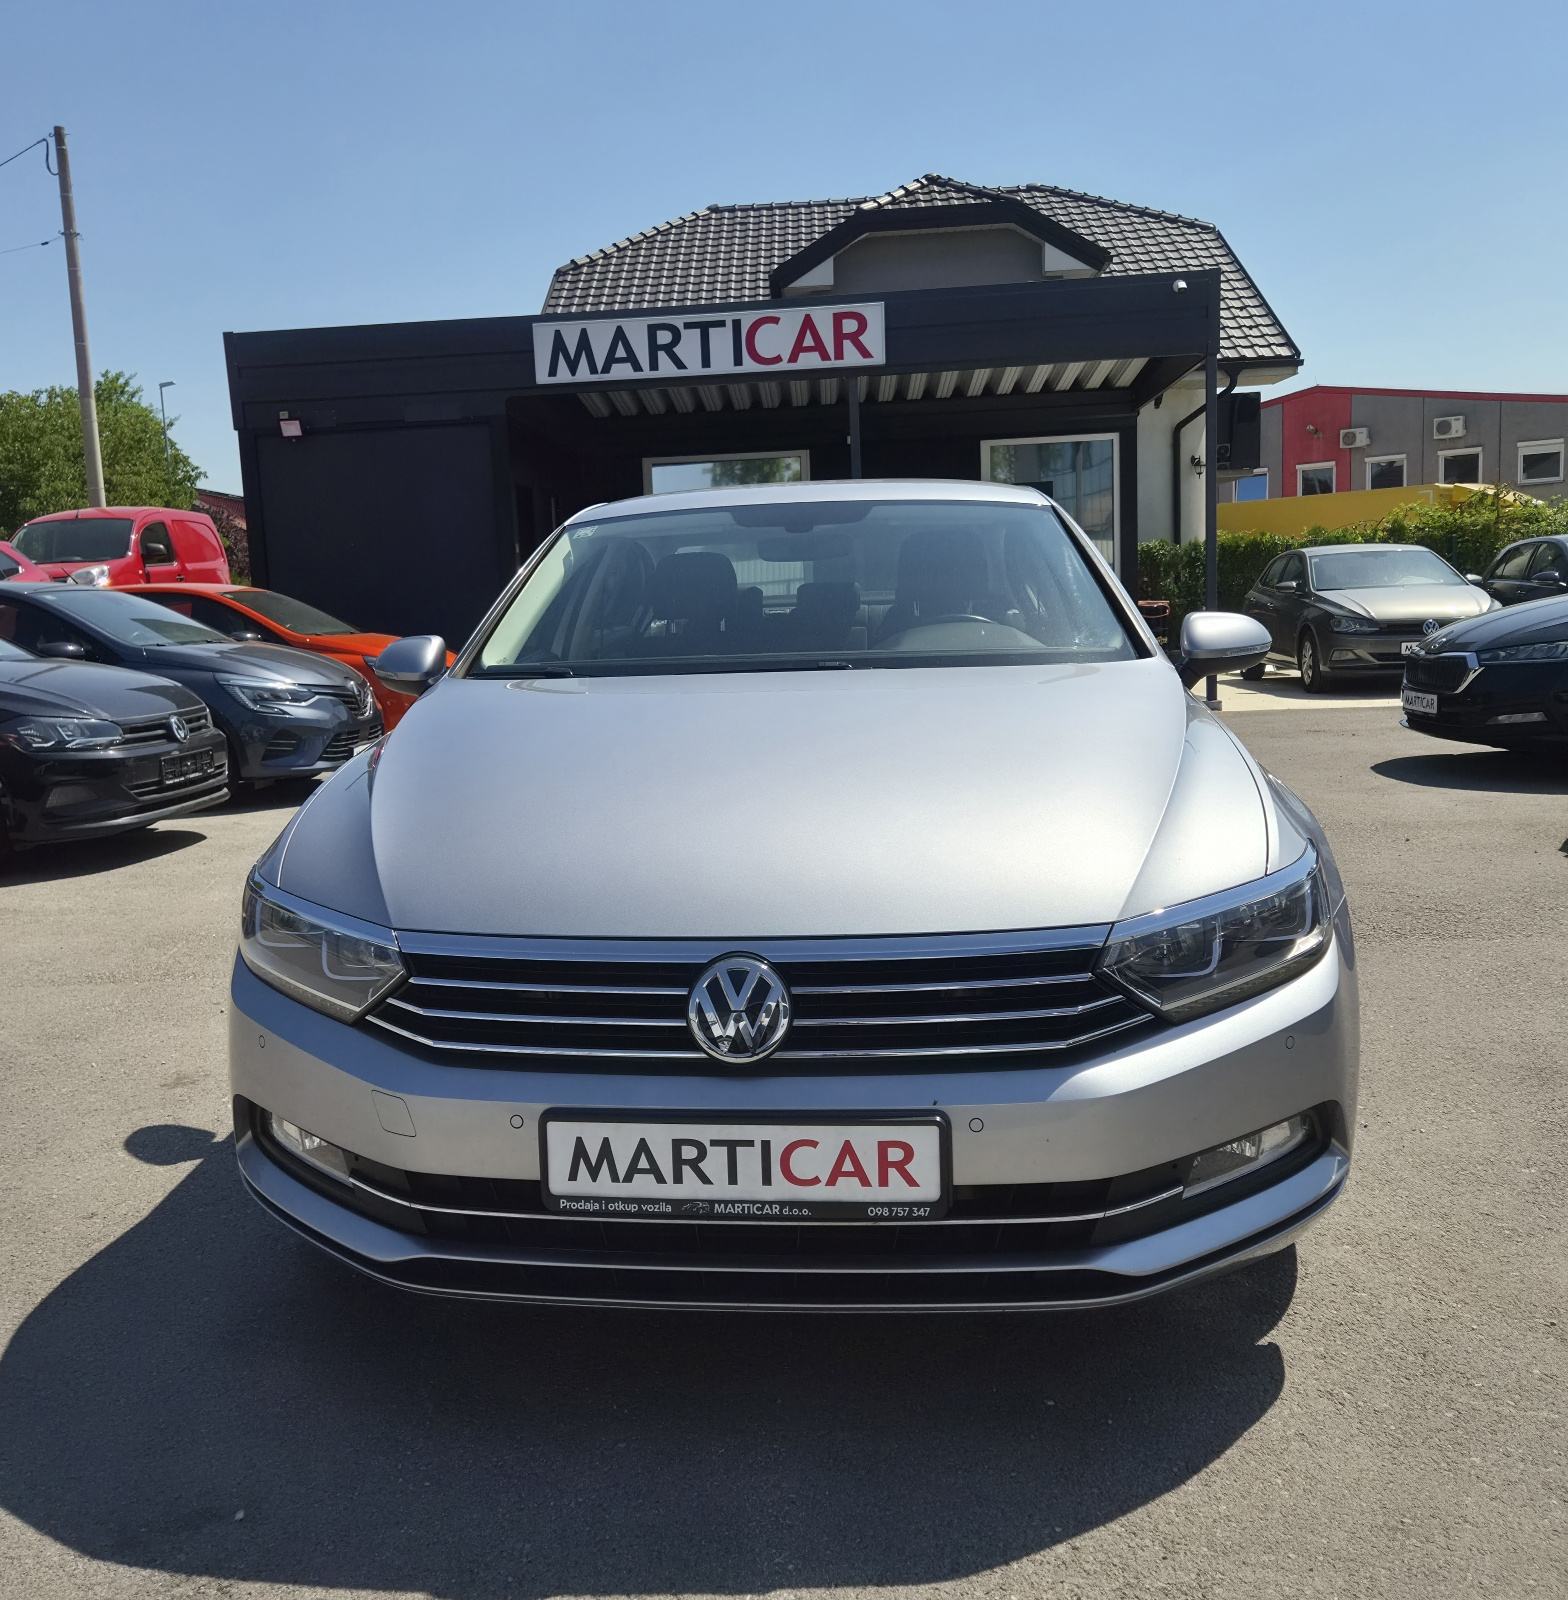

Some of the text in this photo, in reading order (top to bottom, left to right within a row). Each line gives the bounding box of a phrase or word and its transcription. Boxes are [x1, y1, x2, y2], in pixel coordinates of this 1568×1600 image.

[547, 311, 875, 378] MARTICAR
[567, 1136, 921, 1188] MARTICAR
[560, 1199, 600, 1212] Prodaja
[608, 1201, 638, 1213] otkup
[641, 1202, 672, 1213] vozila
[714, 1203, 812, 1216] MARTICAR d.o.o.
[867, 1207, 931, 1217] 098 757 347
